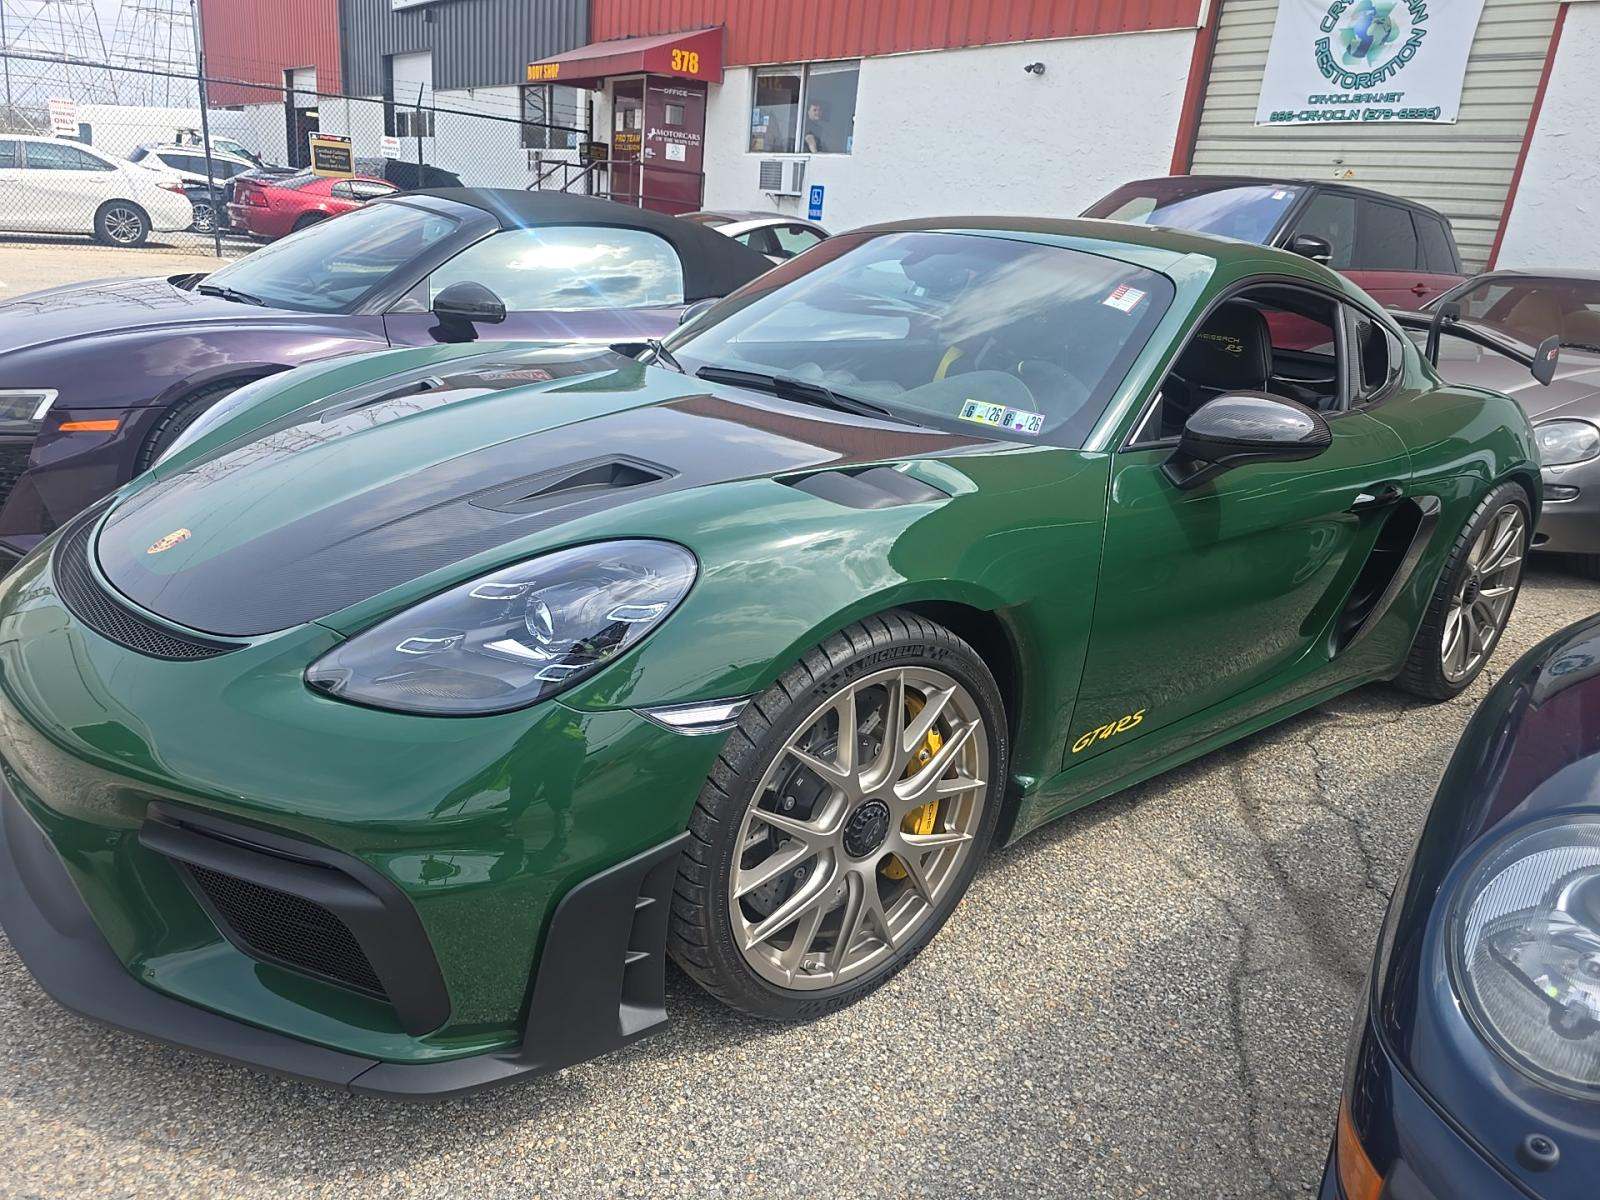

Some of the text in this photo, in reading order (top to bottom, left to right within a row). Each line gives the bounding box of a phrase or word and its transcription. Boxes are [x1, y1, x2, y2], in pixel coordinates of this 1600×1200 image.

[671, 48, 699, 74] 378
[1315, 28, 1427, 90] RESTORATION
[528, 63, 560, 80] BODY SHOP
[664, 88, 688, 97] OFFICE
[1308, 91, 1405, 105] CRYOCLEAN.NET
[54, 117, 74, 125] ONLY
[656, 129, 700, 141] MOTORCARS
[988, 407, 1002, 422] 26
[1028, 416, 1042, 432] 26
[862, 644, 924, 667] MICHELIN
[1072, 708, 1146, 753] GT4RS
